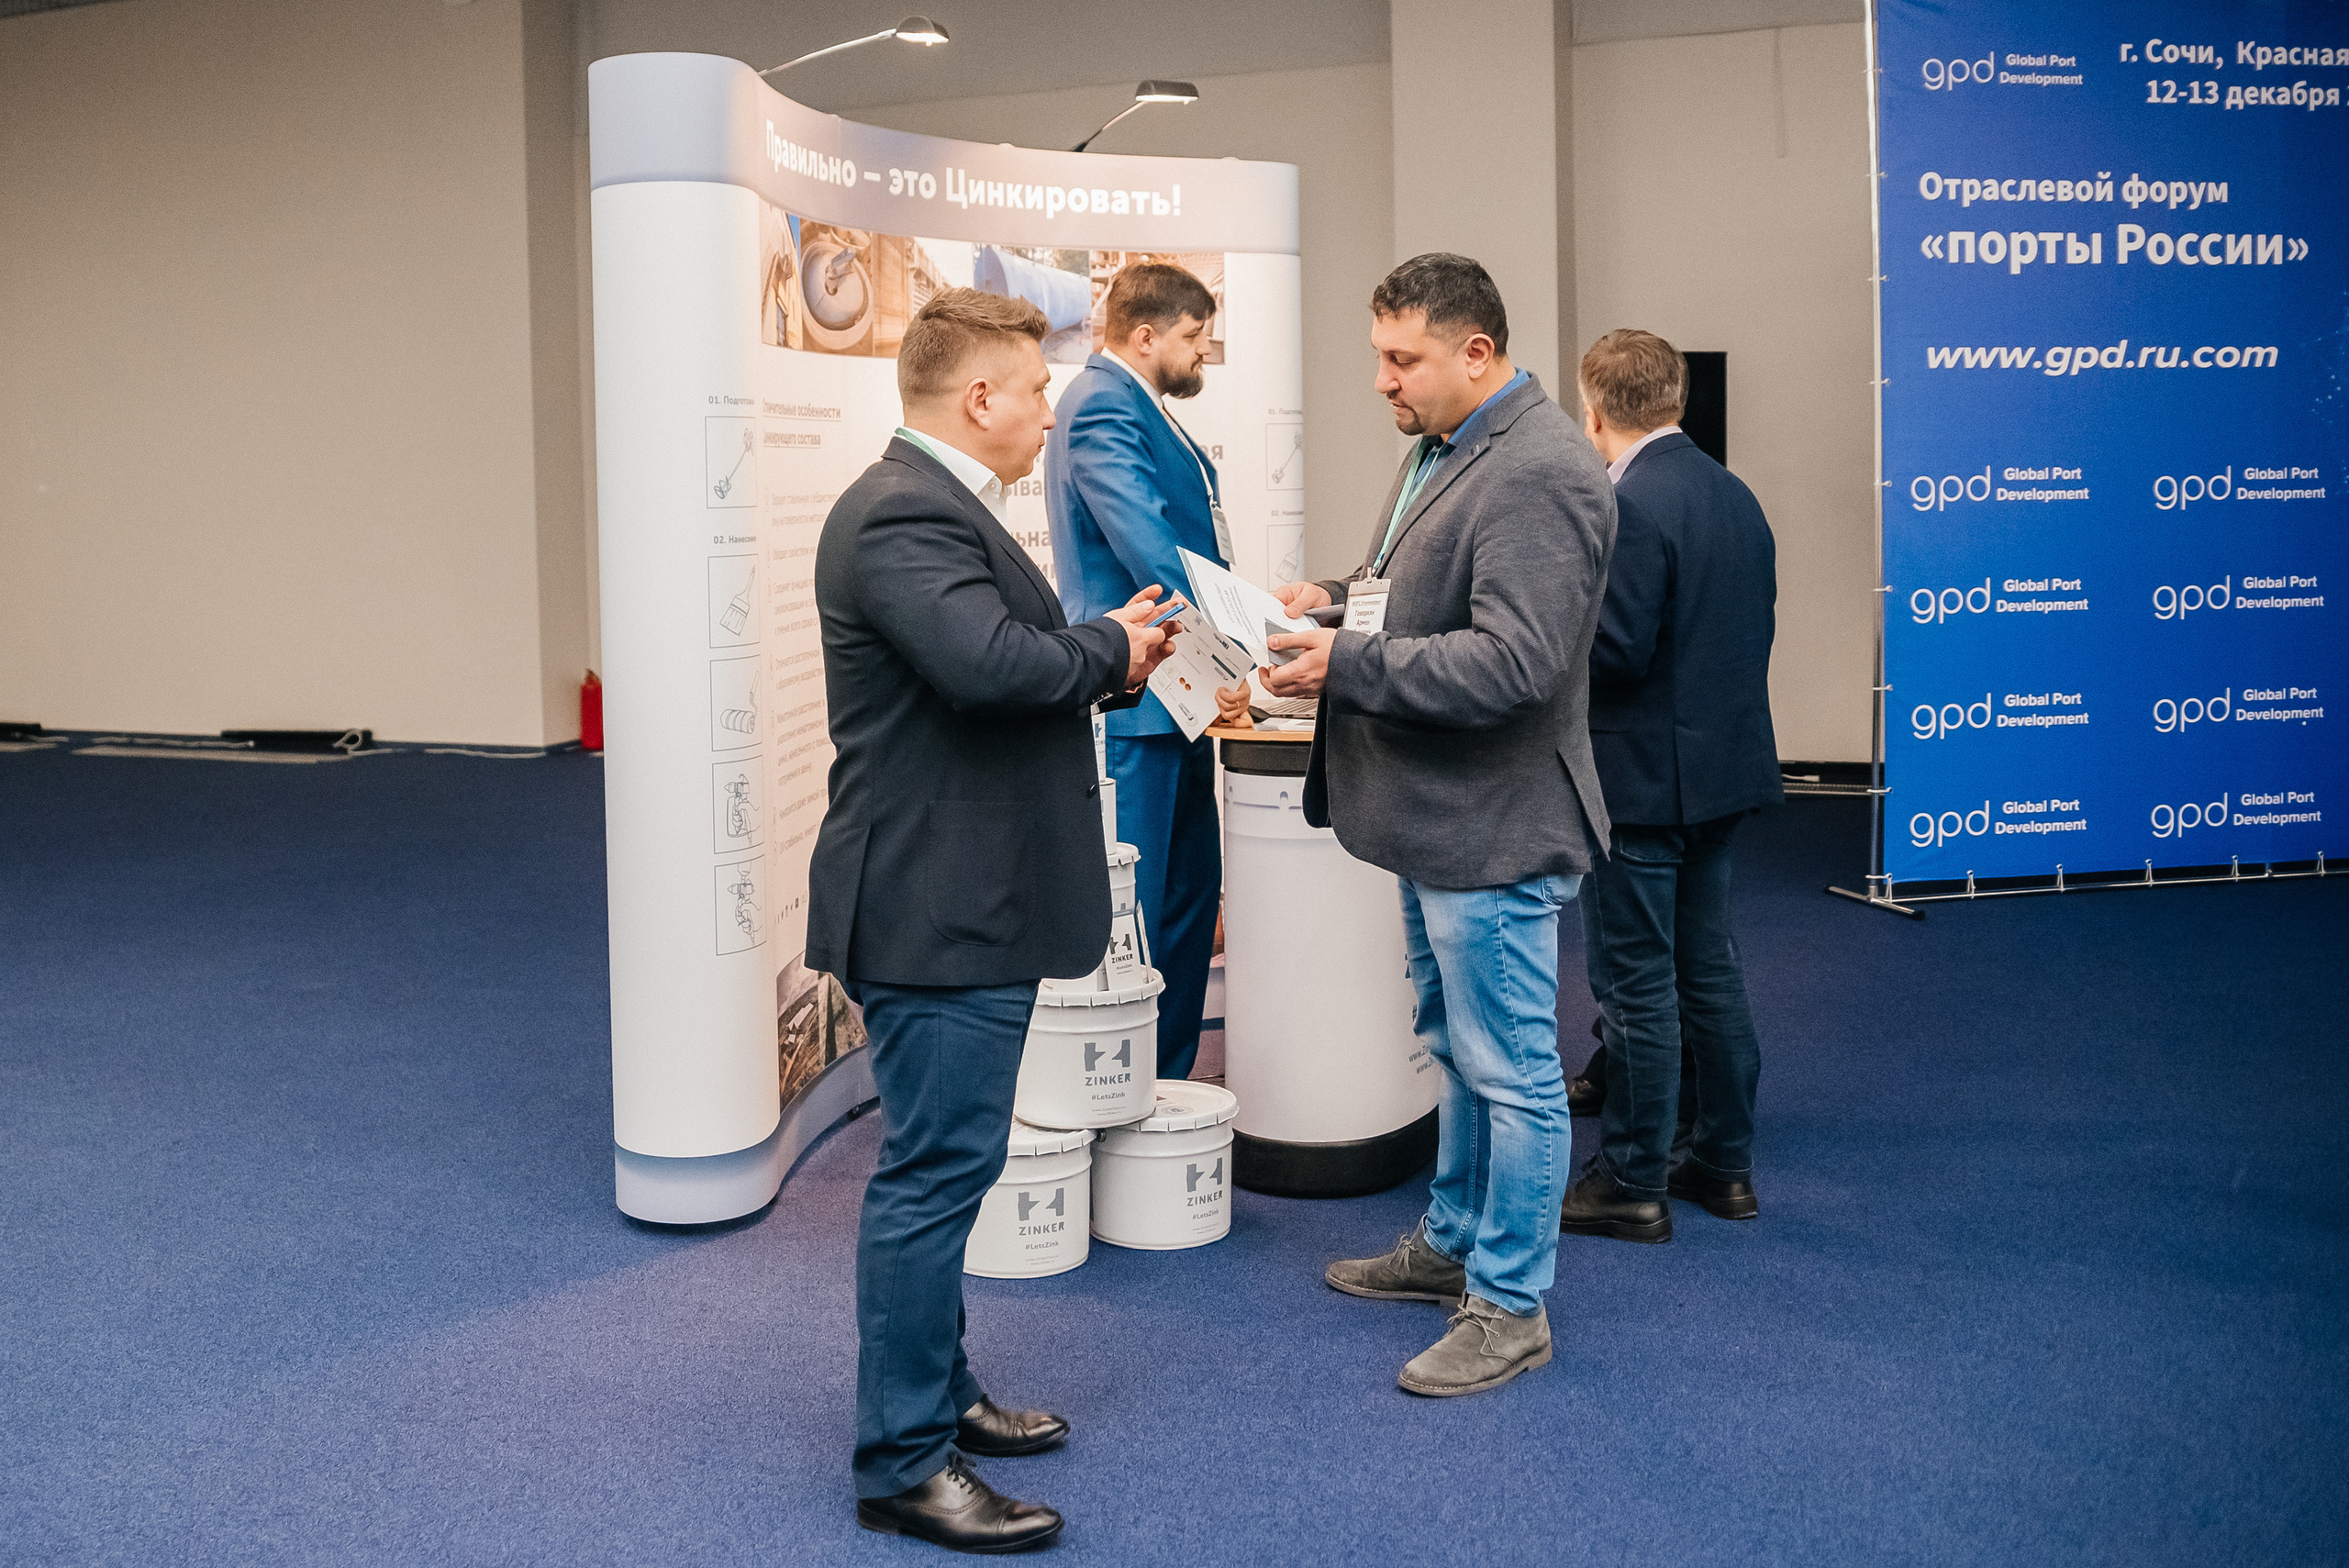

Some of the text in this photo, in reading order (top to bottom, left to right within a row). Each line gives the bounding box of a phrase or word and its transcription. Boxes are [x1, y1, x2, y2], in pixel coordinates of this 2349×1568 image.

[2006, 54, 2076, 66] Global Port
[2121, 39, 2349, 70] г. Сочи, Красная
[1922, 51, 1994, 90] gpd
[1999, 72, 2082, 86] Development
[2147, 80, 2219, 104] 12-13
[2225, 81, 2339, 111] декабря
[764, 118, 857, 187] Правильно
[888, 167, 937, 199] это
[946, 167, 1182, 219] Цинкировать!
[1920, 172, 2228, 209] Отраслевой форум
[1921, 224, 2308, 274] «порты России»
[1927, 339, 2277, 376] www.gpd.ru.com
[708, 395, 721, 405] 01.
[797, 434, 821, 445] состава
[2004, 467, 2081, 480] Global Port
[2244, 467, 2318, 480] Global Port
[1911, 465, 1990, 511] gpd
[1997, 488, 2088, 503] Development
[2154, 466, 2231, 510] gpd
[2237, 487, 2325, 501] Development
[714, 536, 726, 544] 02.
[2003, 578, 2081, 592] Global Port
[2243, 576, 2317, 589] Global Port
[1910, 578, 1990, 624] gpd
[2154, 575, 2230, 619] gpd
[2236, 596, 2323, 609] Development
[1997, 599, 2088, 614] Development
[2004, 693, 2081, 706] Global Port
[2243, 687, 2316, 701] Global Port
[1911, 693, 1991, 740] gpd
[2154, 688, 2230, 732] gpd
[2236, 707, 2323, 721] Development
[1998, 713, 2088, 728] Development
[2003, 799, 2079, 814] Global Port
[2242, 792, 2314, 806] Global Port
[2152, 793, 2227, 838] gpd
[2233, 811, 2321, 826] Development
[1910, 800, 1989, 847] gpd
[1995, 819, 2087, 834] Development
[1111, 953, 1133, 963] ZINKER
[1085, 1073, 1130, 1086] ZINKER
[1092, 1092, 1126, 1100] #LetsZink
[1187, 1190, 1223, 1207] ZINKER
[1193, 1208, 1219, 1219] #LetsZink
[1019, 1221, 1064, 1236] ZINKER
[1025, 1240, 1059, 1250] #LetsZink
